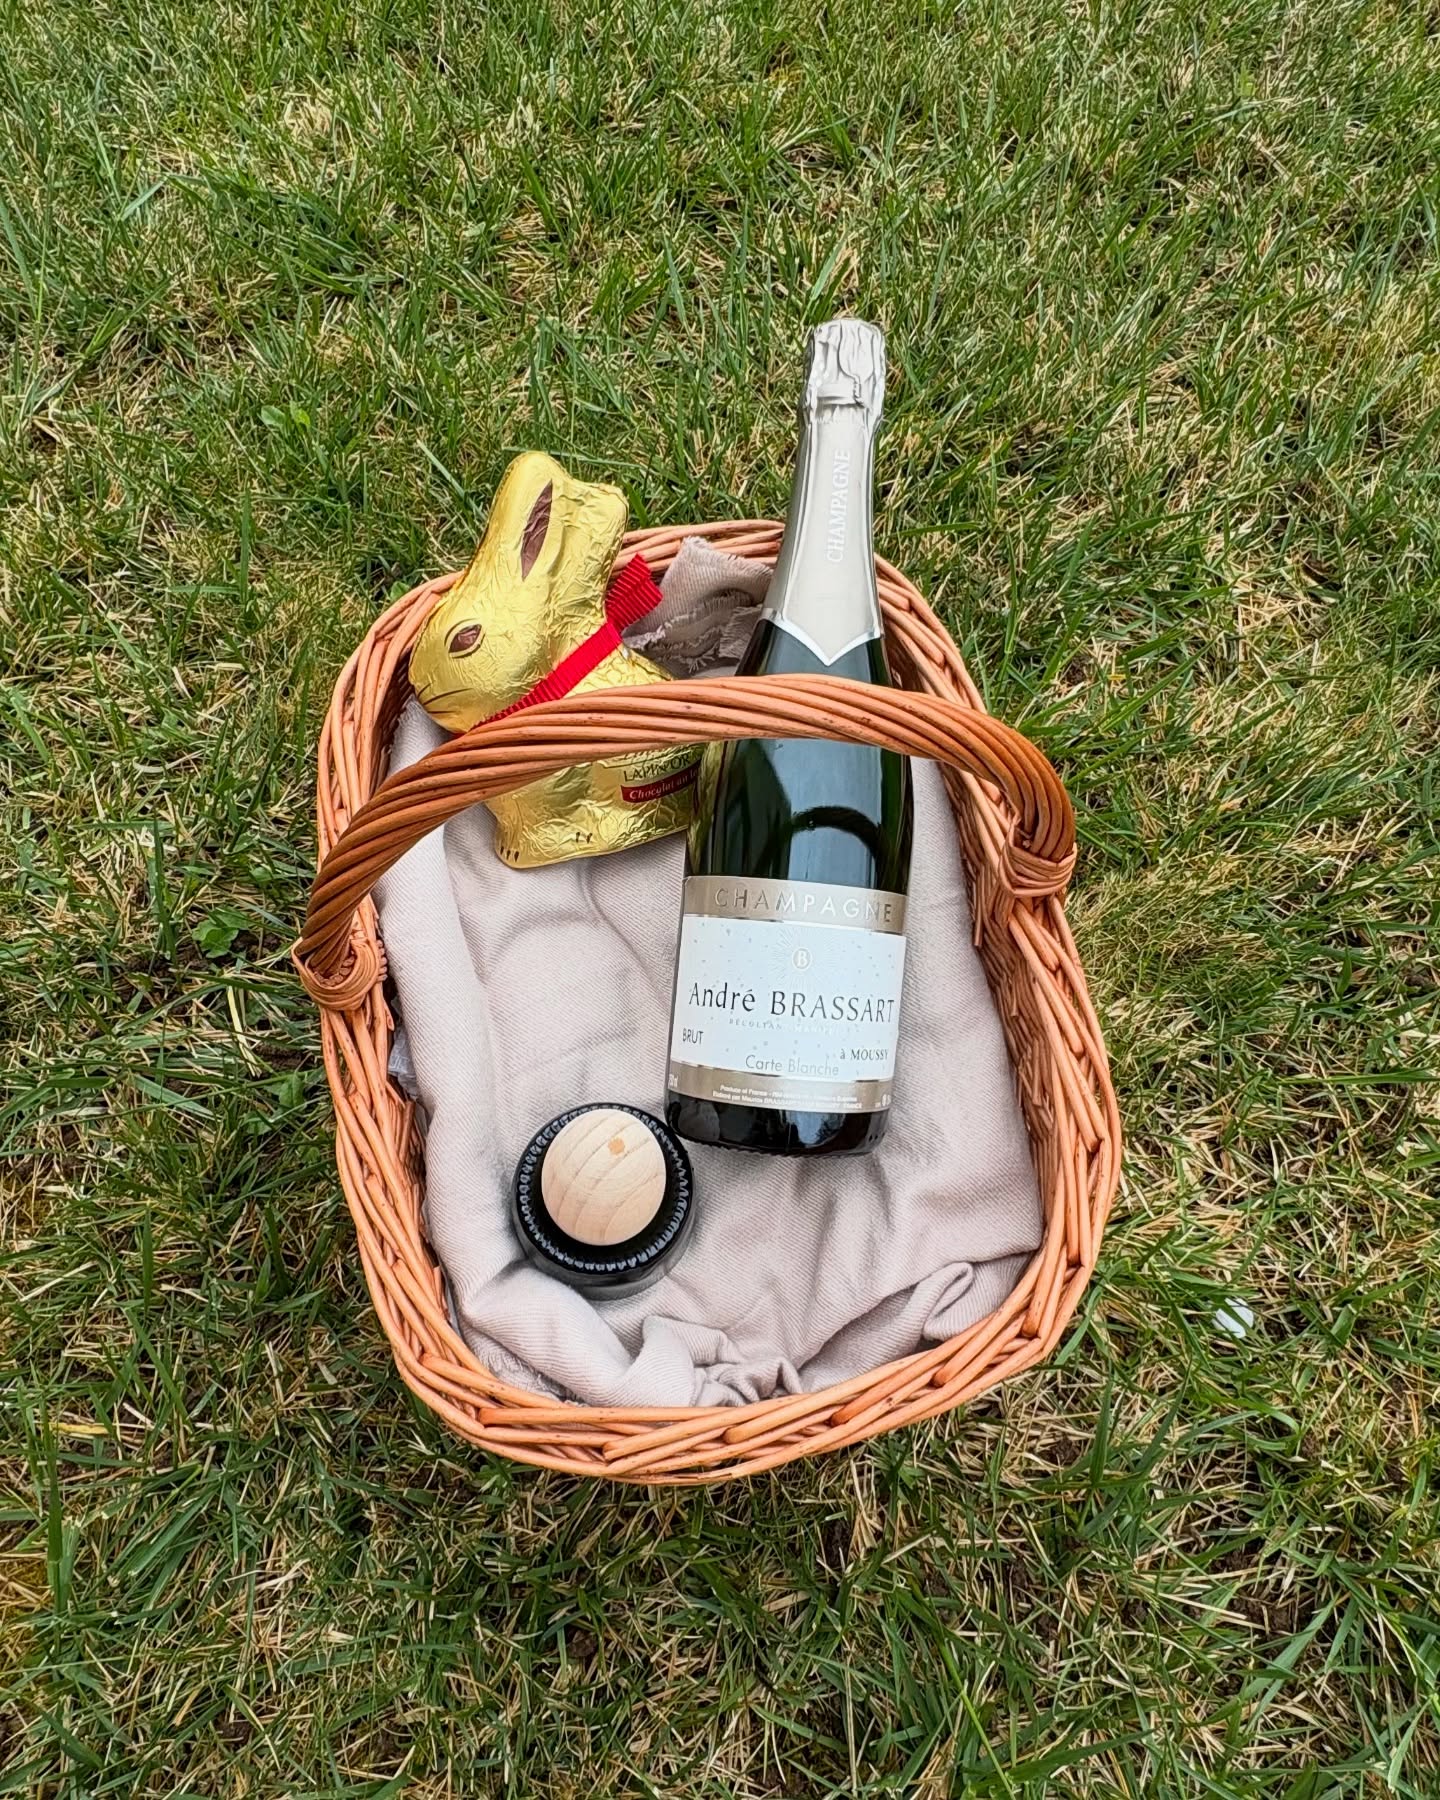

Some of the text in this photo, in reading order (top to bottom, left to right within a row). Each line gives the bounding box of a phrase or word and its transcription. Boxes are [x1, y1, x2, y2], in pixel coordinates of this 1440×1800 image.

[826, 449, 850, 562] CHAMPAGNE
[629, 780, 675, 800] Chocolat
[714, 887, 893, 923] CHAMPAGNE
[688, 981, 895, 1024] André BRASSART
[682, 1027, 704, 1045] BRUT
[745, 1054, 840, 1077] Carte Blanche
[840, 1048, 889, 1061] à MOUSSY
